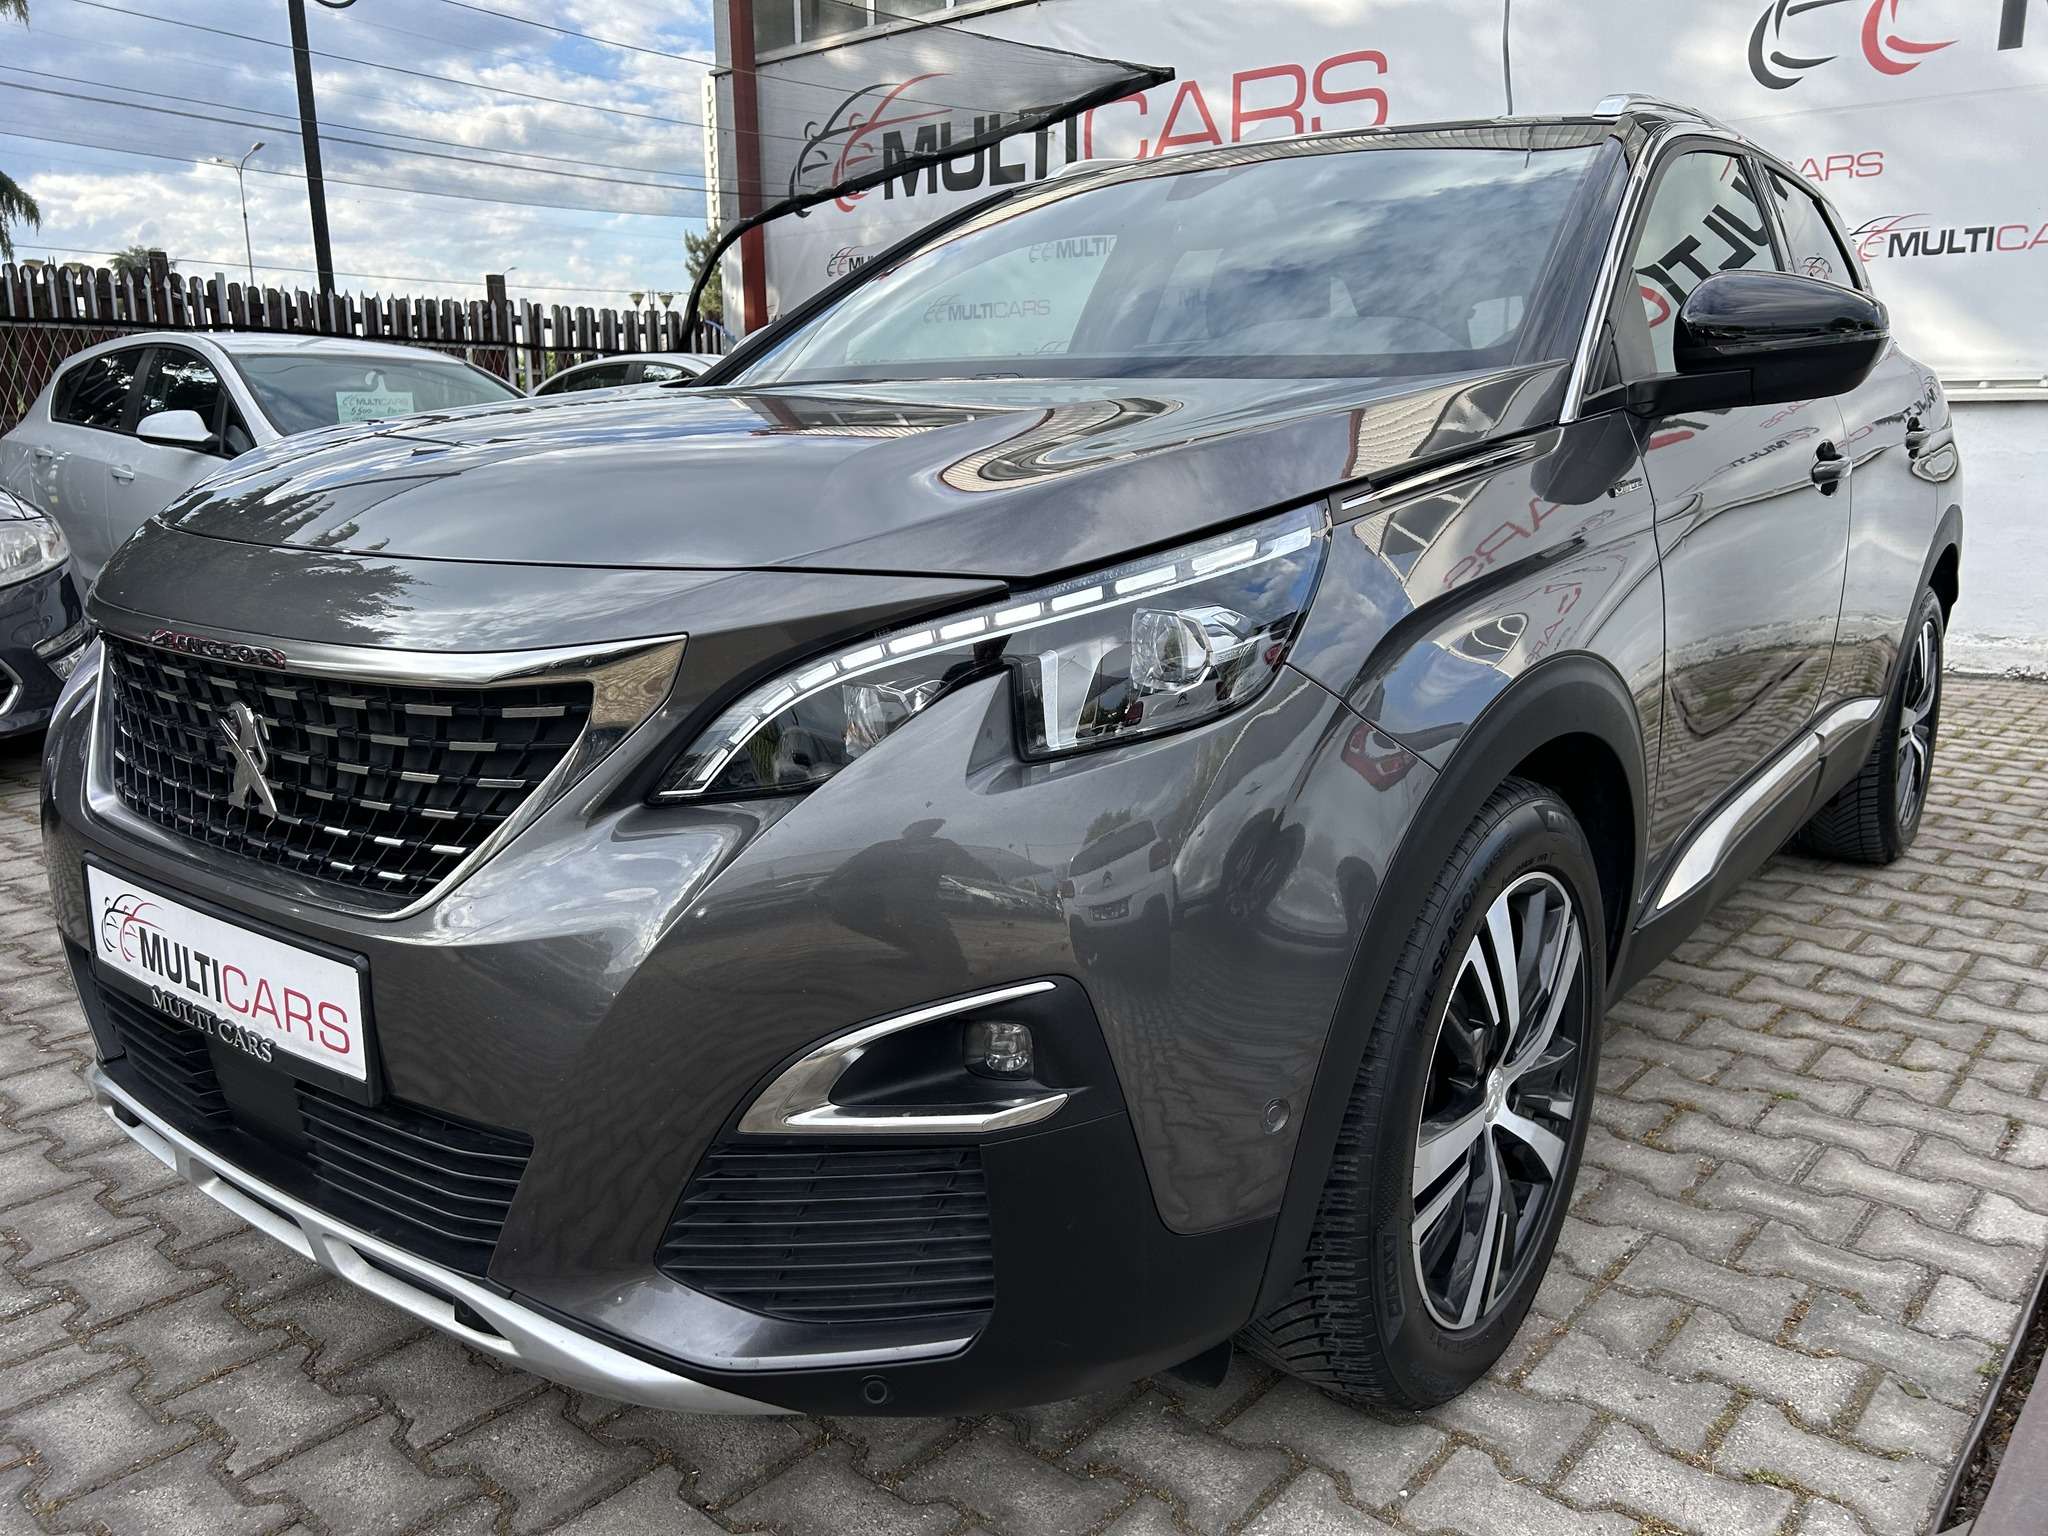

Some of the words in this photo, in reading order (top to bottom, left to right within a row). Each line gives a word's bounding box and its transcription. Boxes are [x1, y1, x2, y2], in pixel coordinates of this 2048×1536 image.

[1787, 151, 1884, 182] ARS
[139, 926, 350, 1054] MULTICARS
[152, 986, 215, 1035] MULTI
[217, 1019, 275, 1063] CARS
